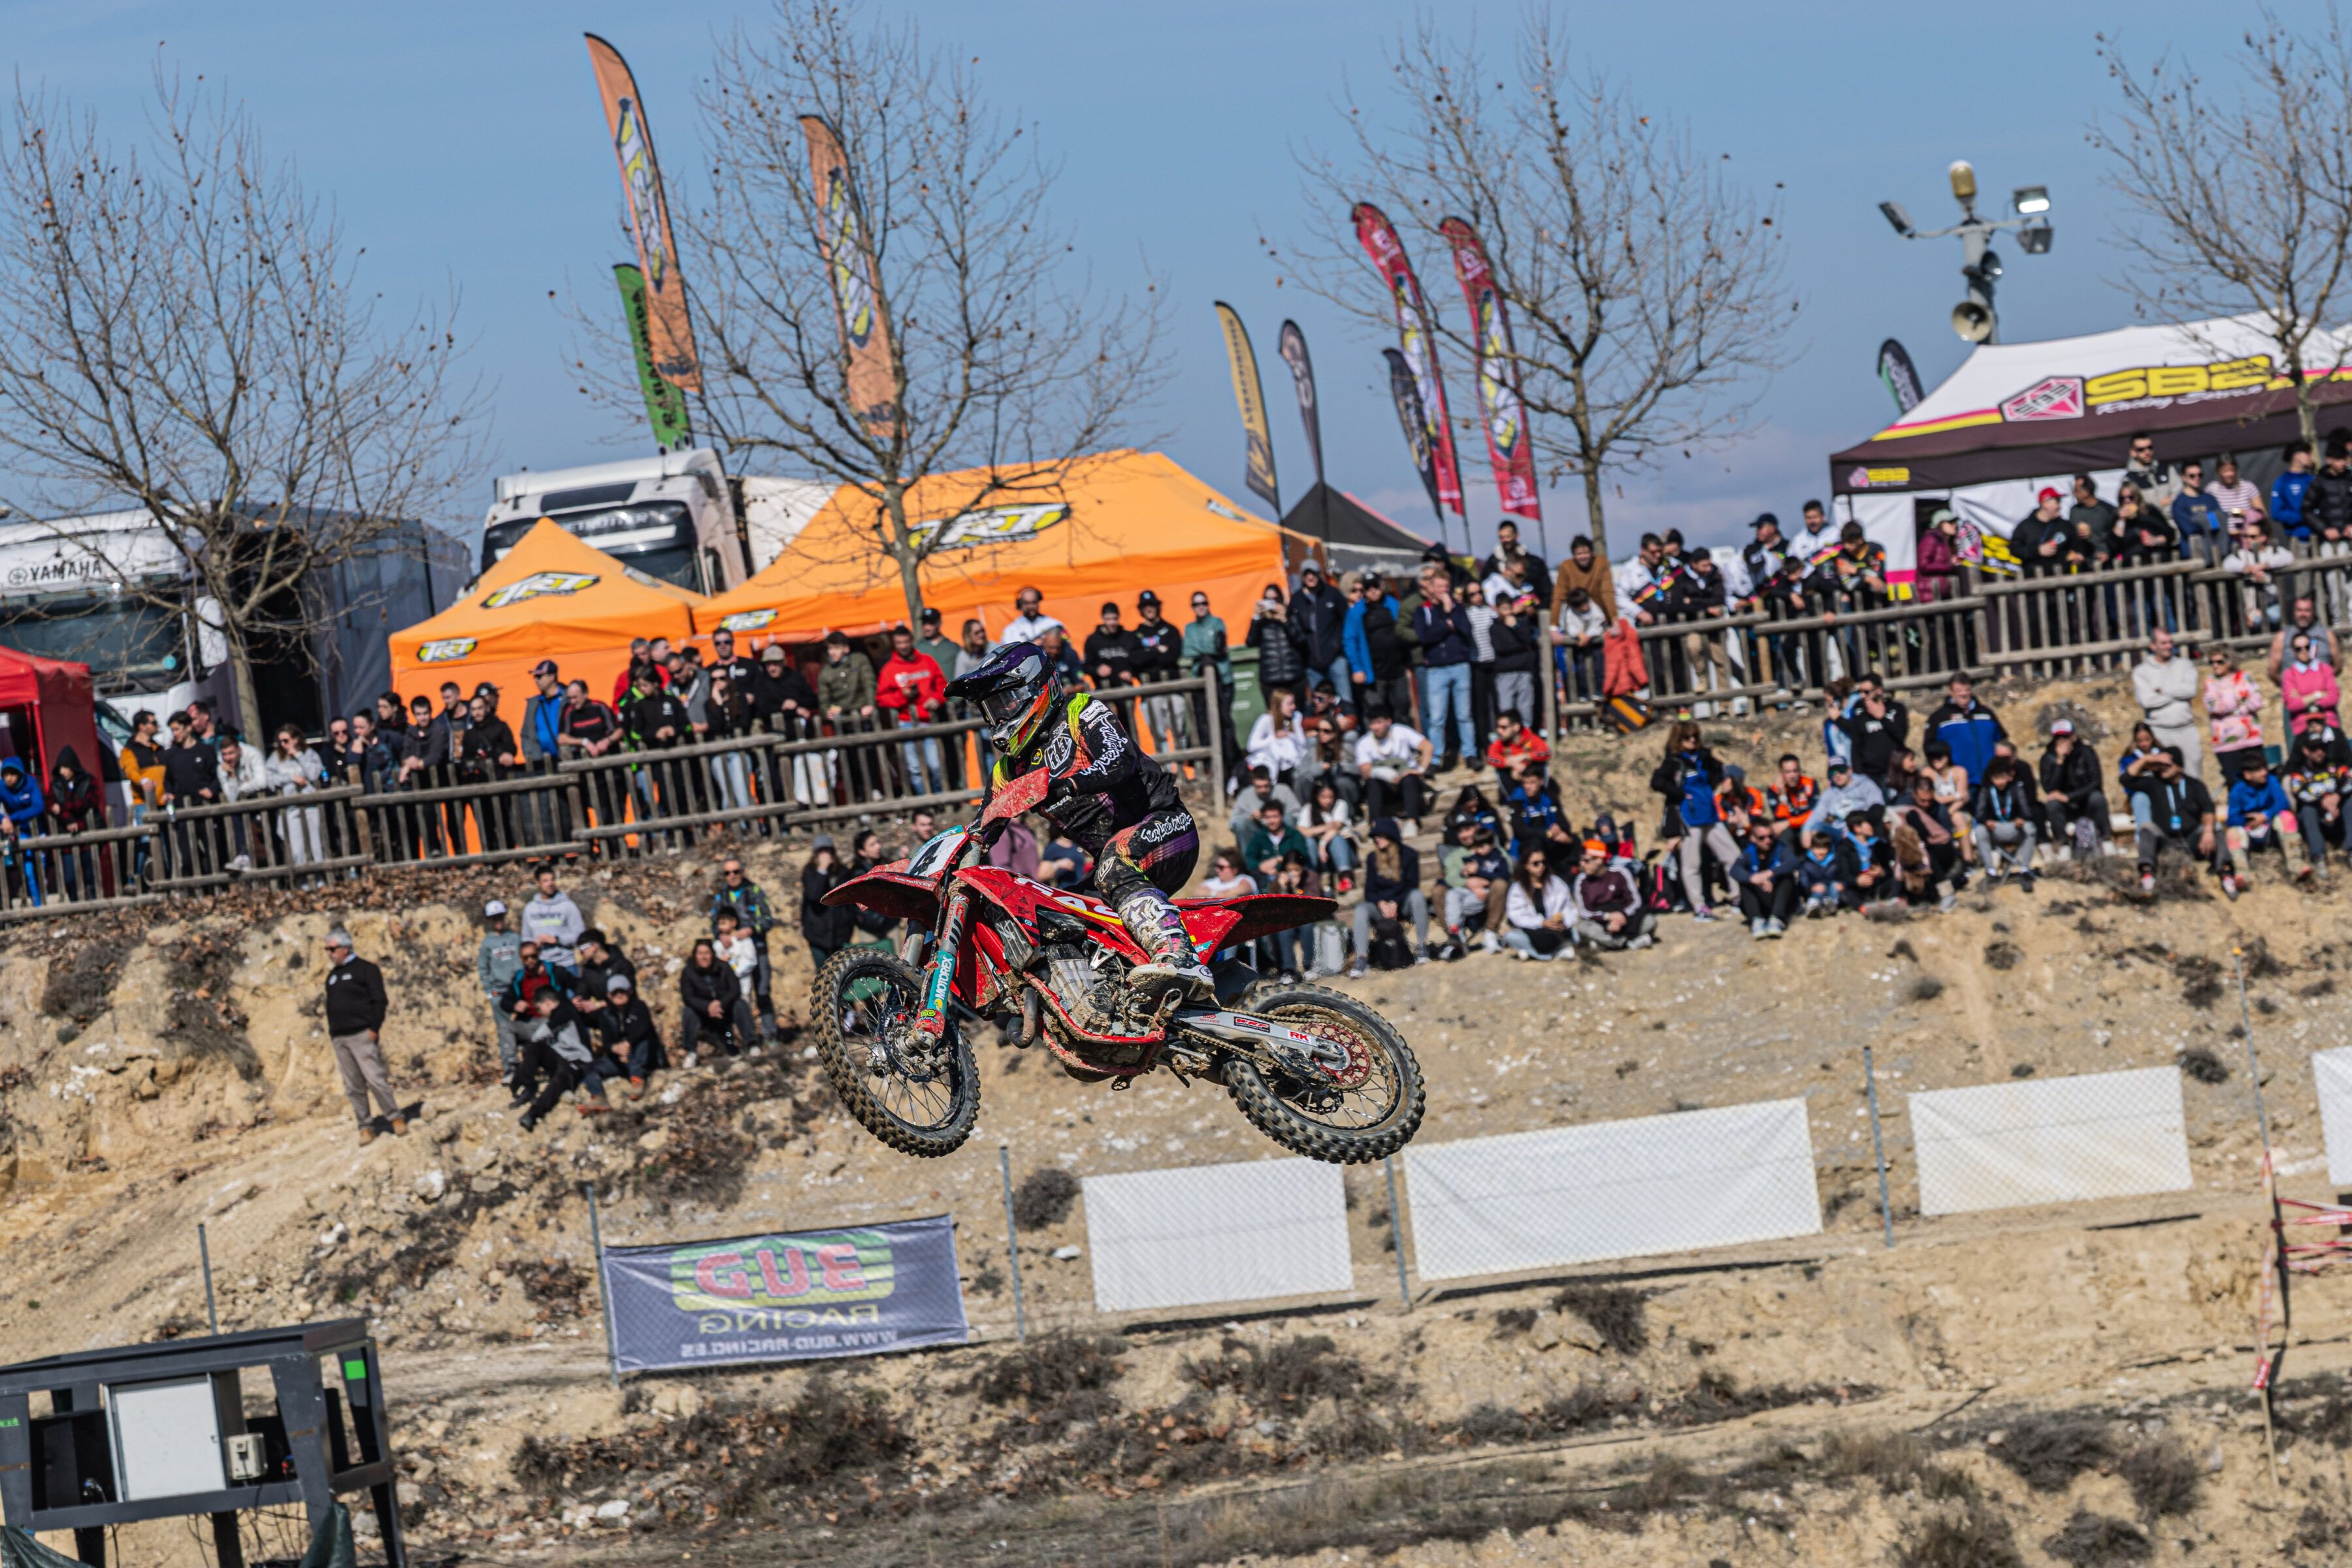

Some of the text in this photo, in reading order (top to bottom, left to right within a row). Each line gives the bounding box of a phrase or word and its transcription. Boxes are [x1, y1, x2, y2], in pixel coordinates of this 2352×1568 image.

[30, 559, 102, 580] YAMAHA
[489, 572, 598, 608] TRT
[419, 638, 478, 662] TRT
[909, 840, 944, 875] 4
[938, 956, 953, 1000] MOTOREX
[1236, 1018, 1270, 1028] WRP
[1290, 1030, 1309, 1041] RK
